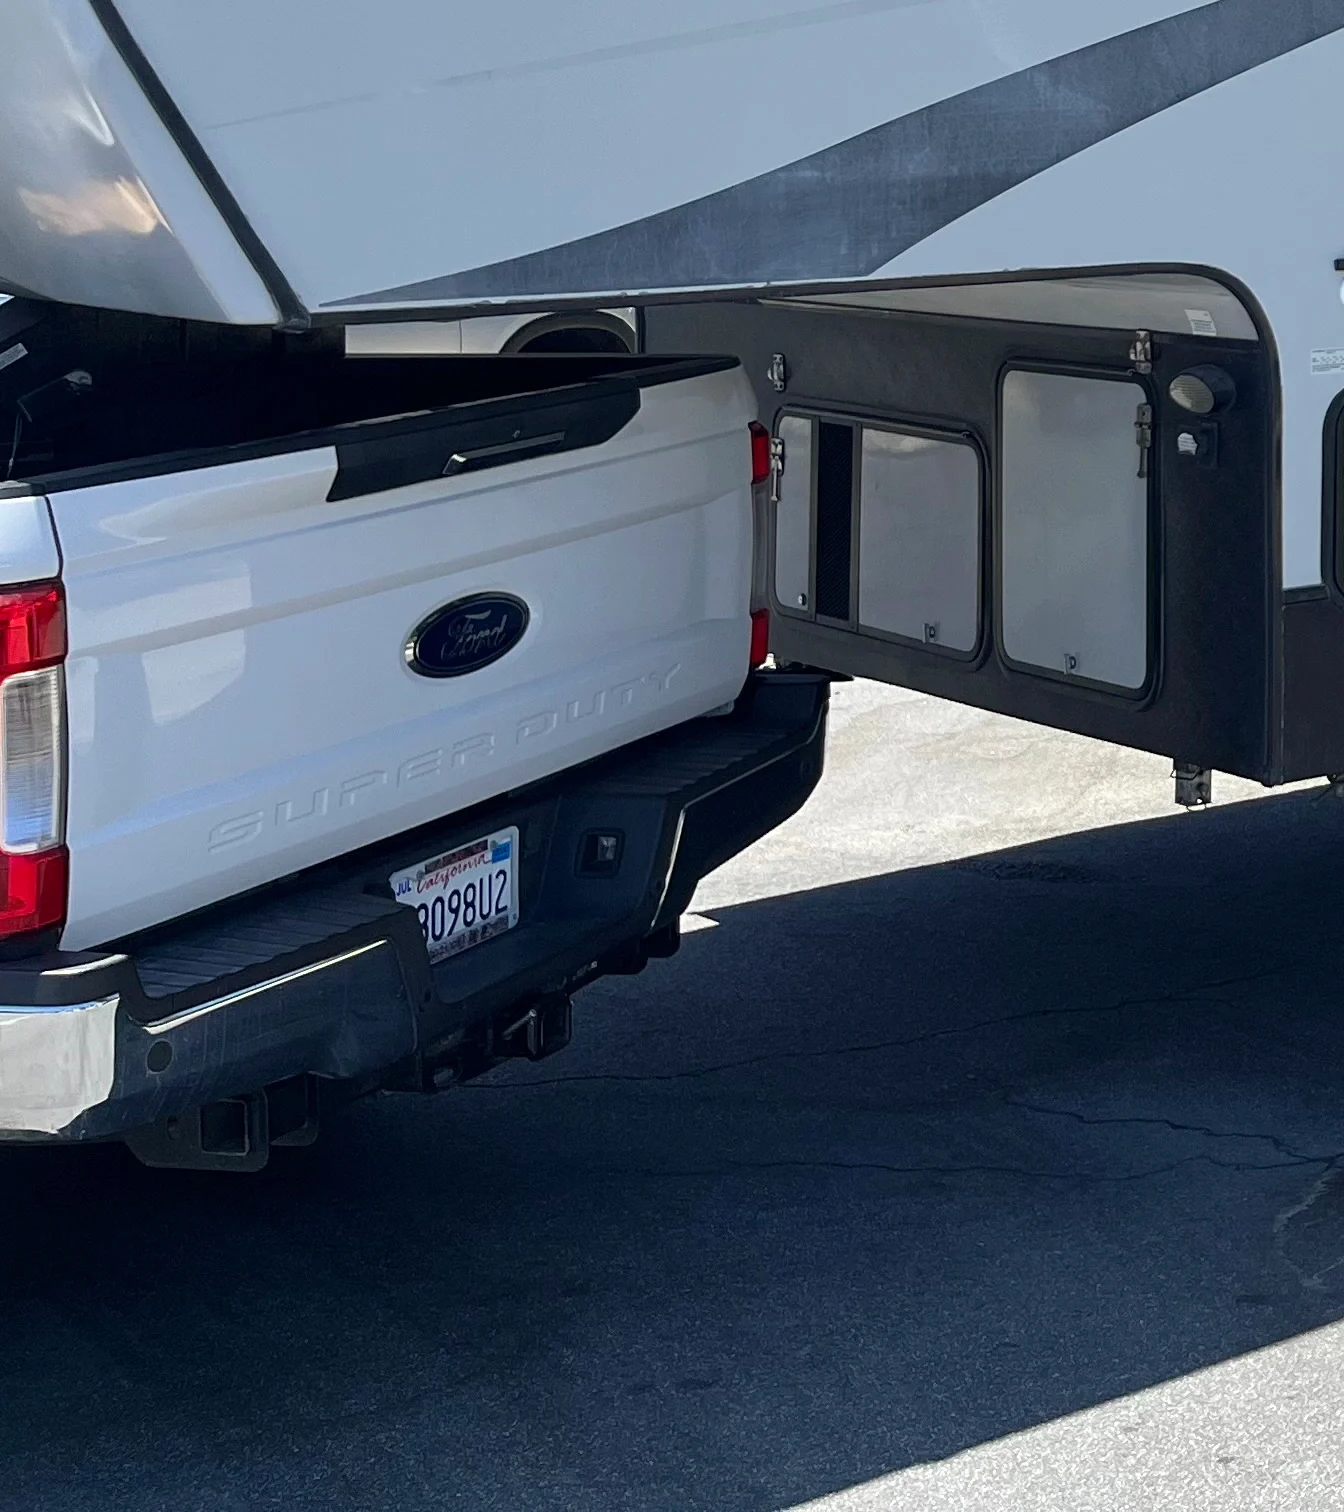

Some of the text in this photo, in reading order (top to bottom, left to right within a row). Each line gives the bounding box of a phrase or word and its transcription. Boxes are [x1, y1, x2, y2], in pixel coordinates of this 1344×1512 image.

[440, 609, 507, 661] Ford
[208, 662, 682, 854] SUPER DUTY
[397, 879, 411, 896] JUL
[417, 853, 491, 894] California
